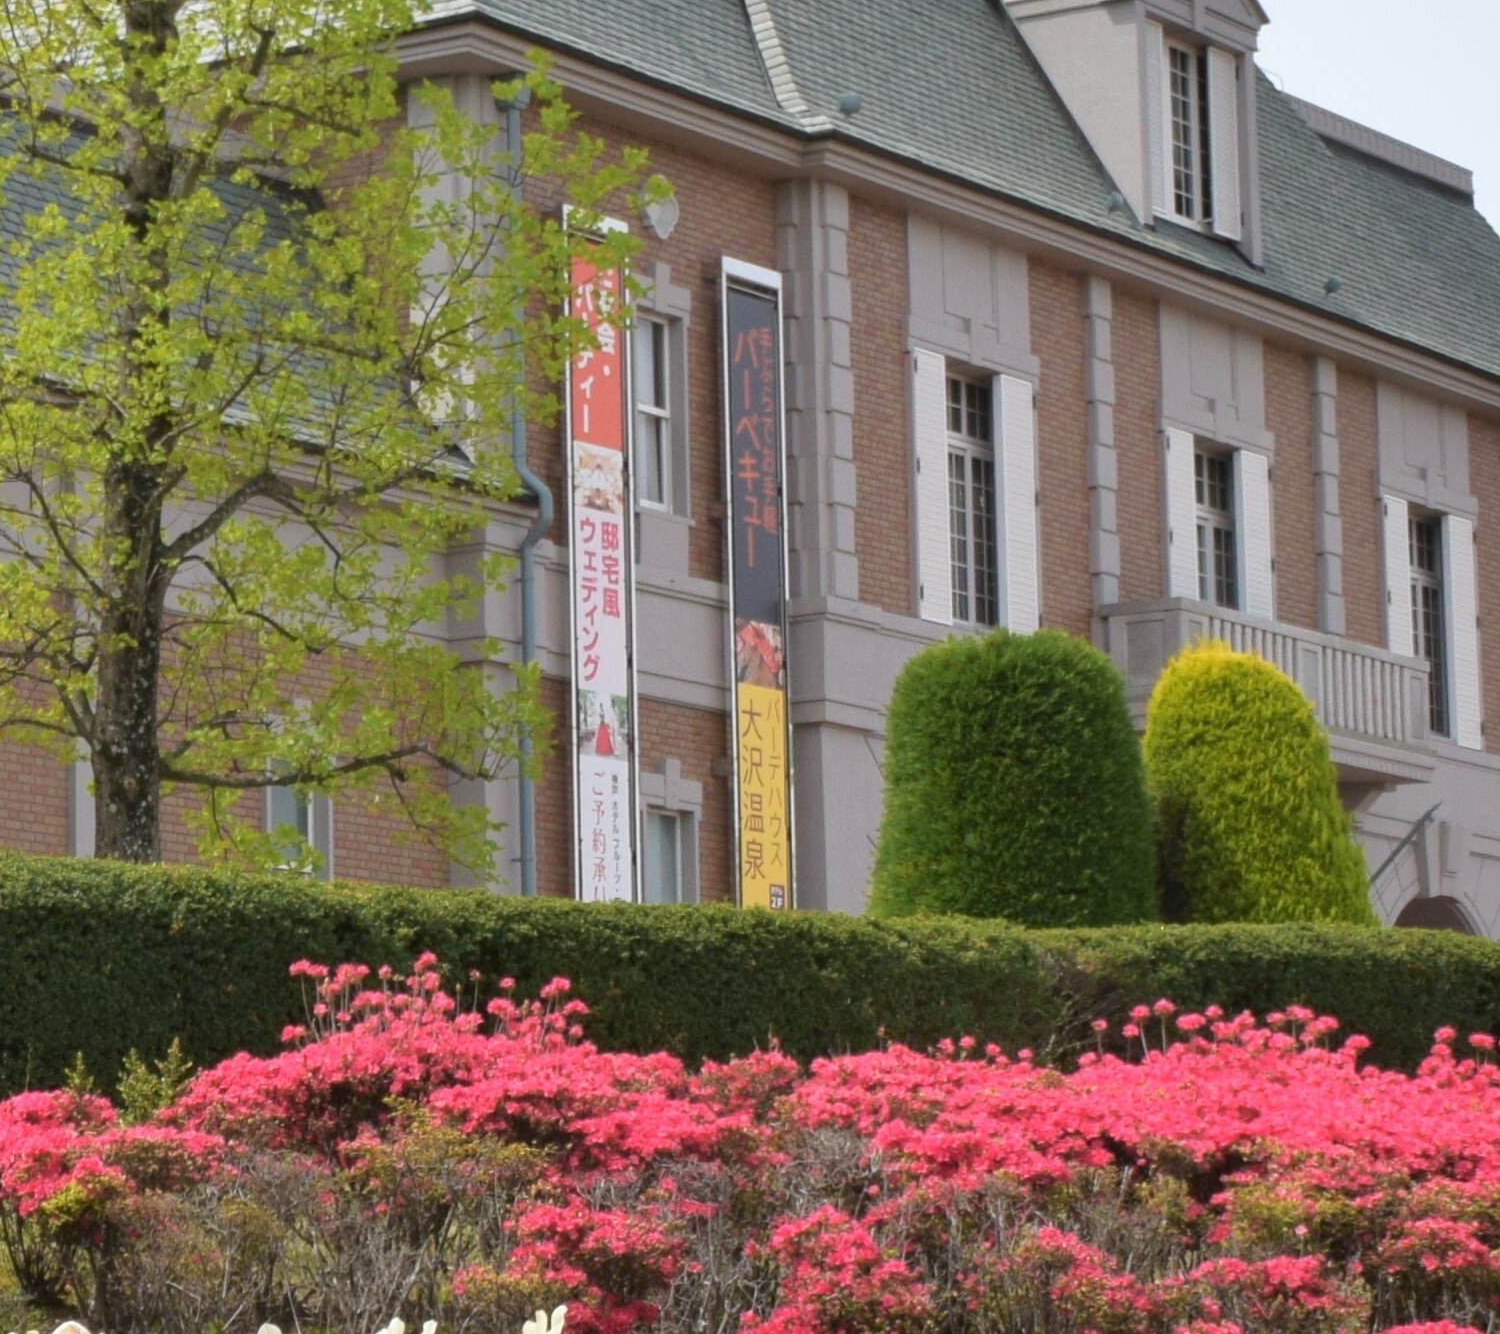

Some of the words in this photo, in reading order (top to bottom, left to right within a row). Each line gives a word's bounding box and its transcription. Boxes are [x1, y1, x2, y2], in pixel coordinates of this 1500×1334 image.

[735, 329, 761, 568] バーベキュー
[580, 517, 600, 682] ウェディング
[601, 521, 620, 618] 邸宅風
[591, 771, 607, 902] ご予約承り
[741, 698, 766, 880] 大沢温泉
[766, 698, 783, 867] バーデハウス
[771, 896, 783, 908] 2F
